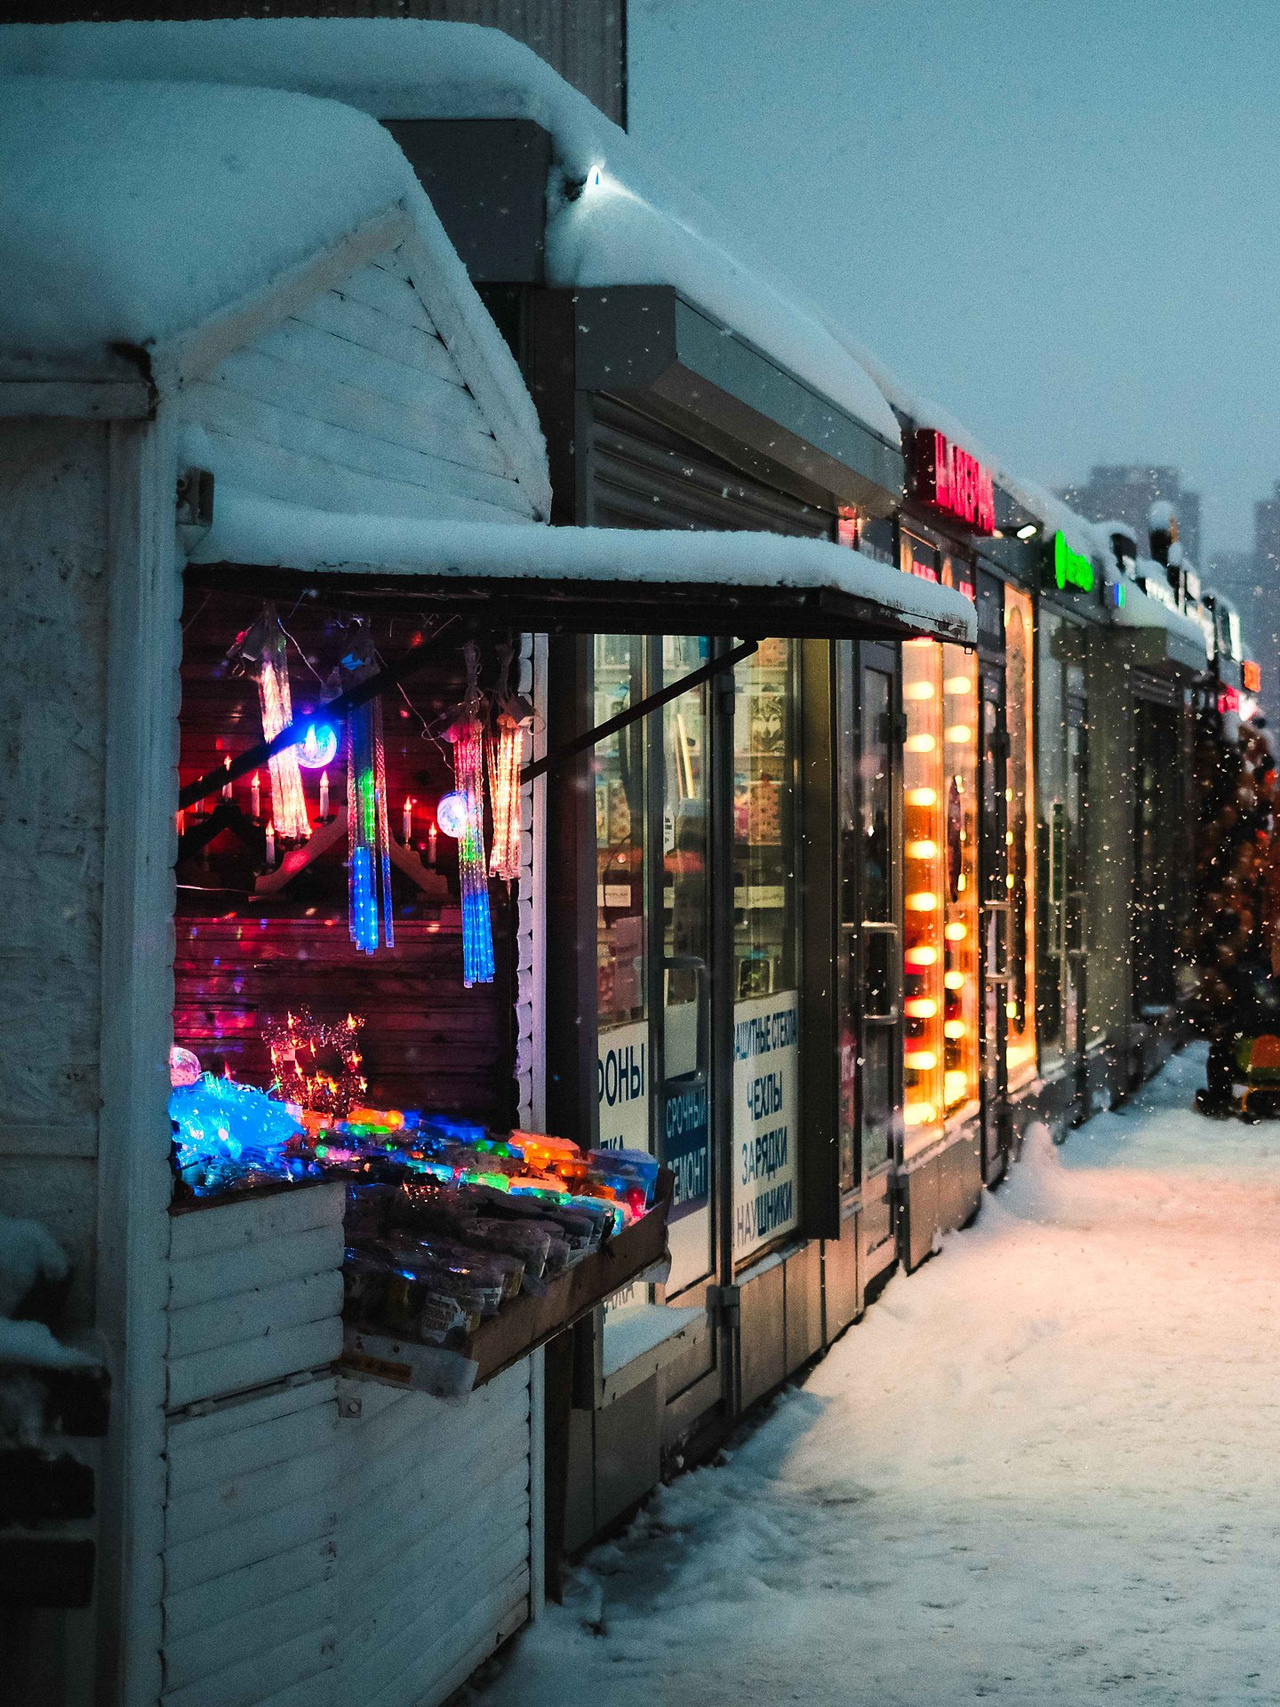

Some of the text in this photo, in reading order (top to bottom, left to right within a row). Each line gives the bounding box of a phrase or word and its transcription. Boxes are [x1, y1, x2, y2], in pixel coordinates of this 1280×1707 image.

[734, 1015, 770, 1061] АЩИТНЫЕ
[747, 1071, 783, 1122] ЧЕХЛЫ
[742, 1126, 788, 1185] ЗАРЯДКИ
[737, 1180, 793, 1247] НАУШНИКИ
